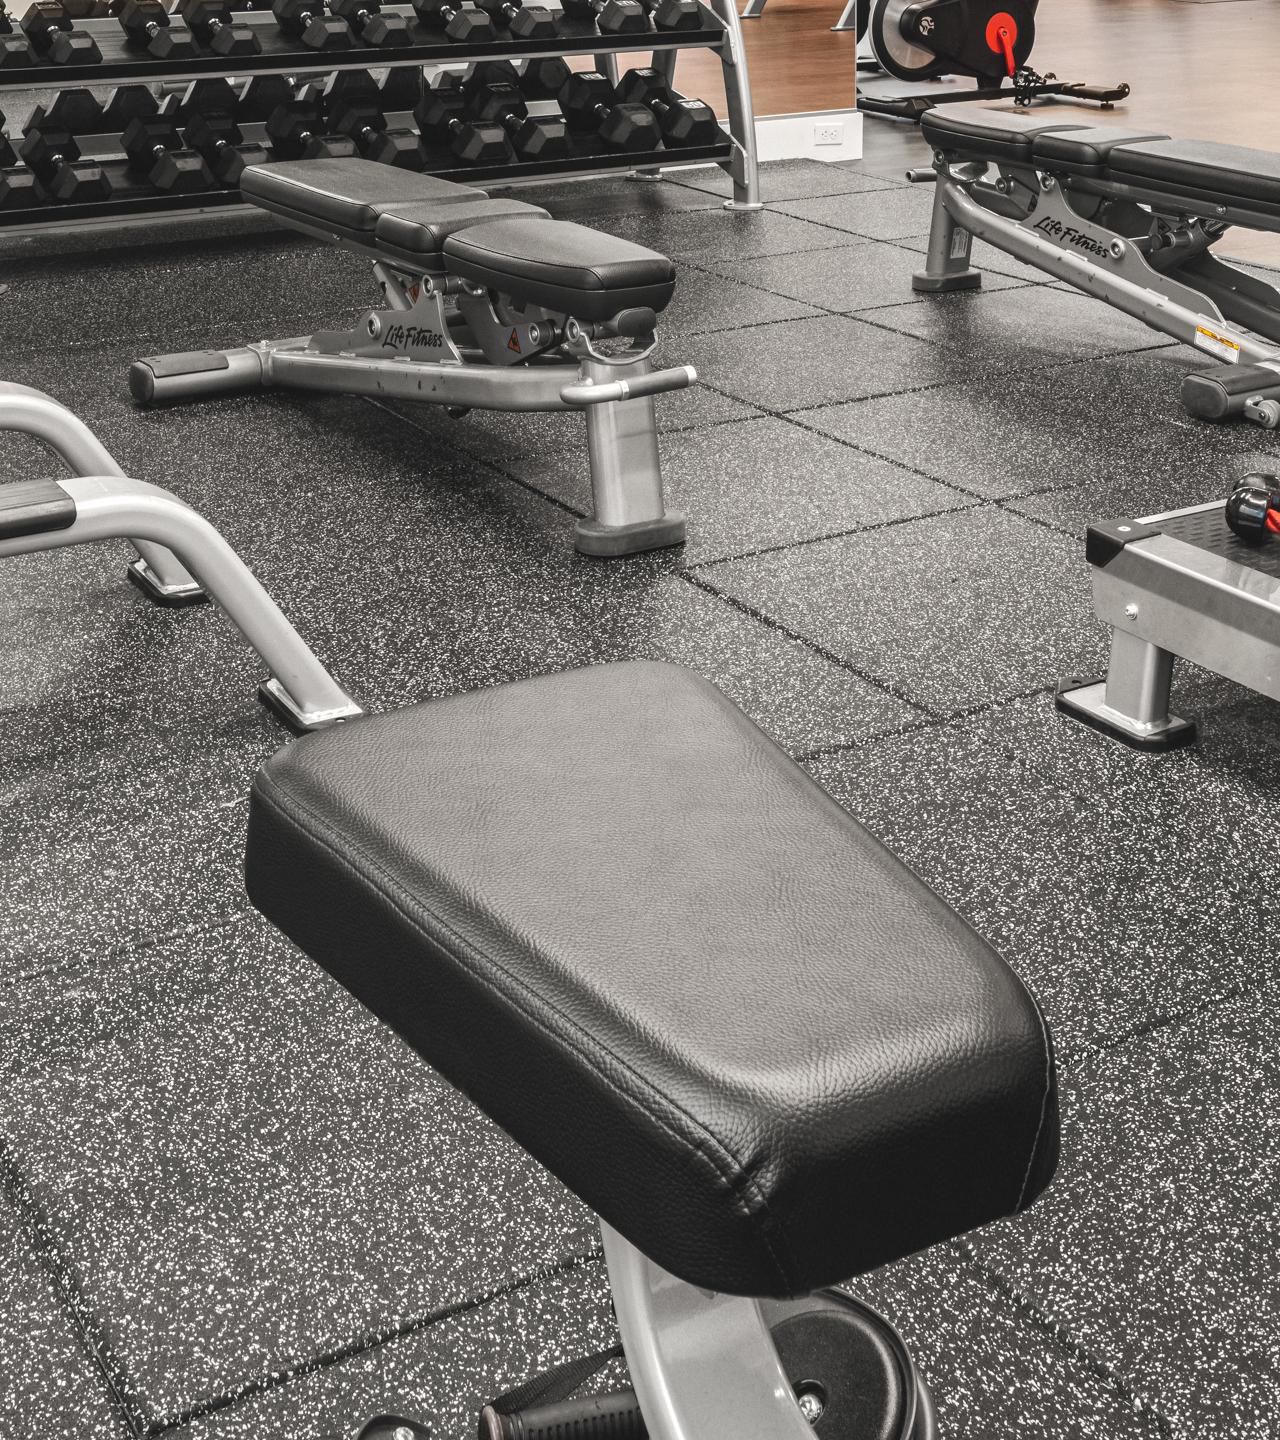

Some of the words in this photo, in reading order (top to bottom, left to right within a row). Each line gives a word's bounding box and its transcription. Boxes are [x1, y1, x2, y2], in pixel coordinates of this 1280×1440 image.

[1033, 215, 1063, 237] Life
[1059, 227, 1110, 258] Fitness
[382, 324, 404, 350] Life
[404, 326, 443, 350] Fitness
